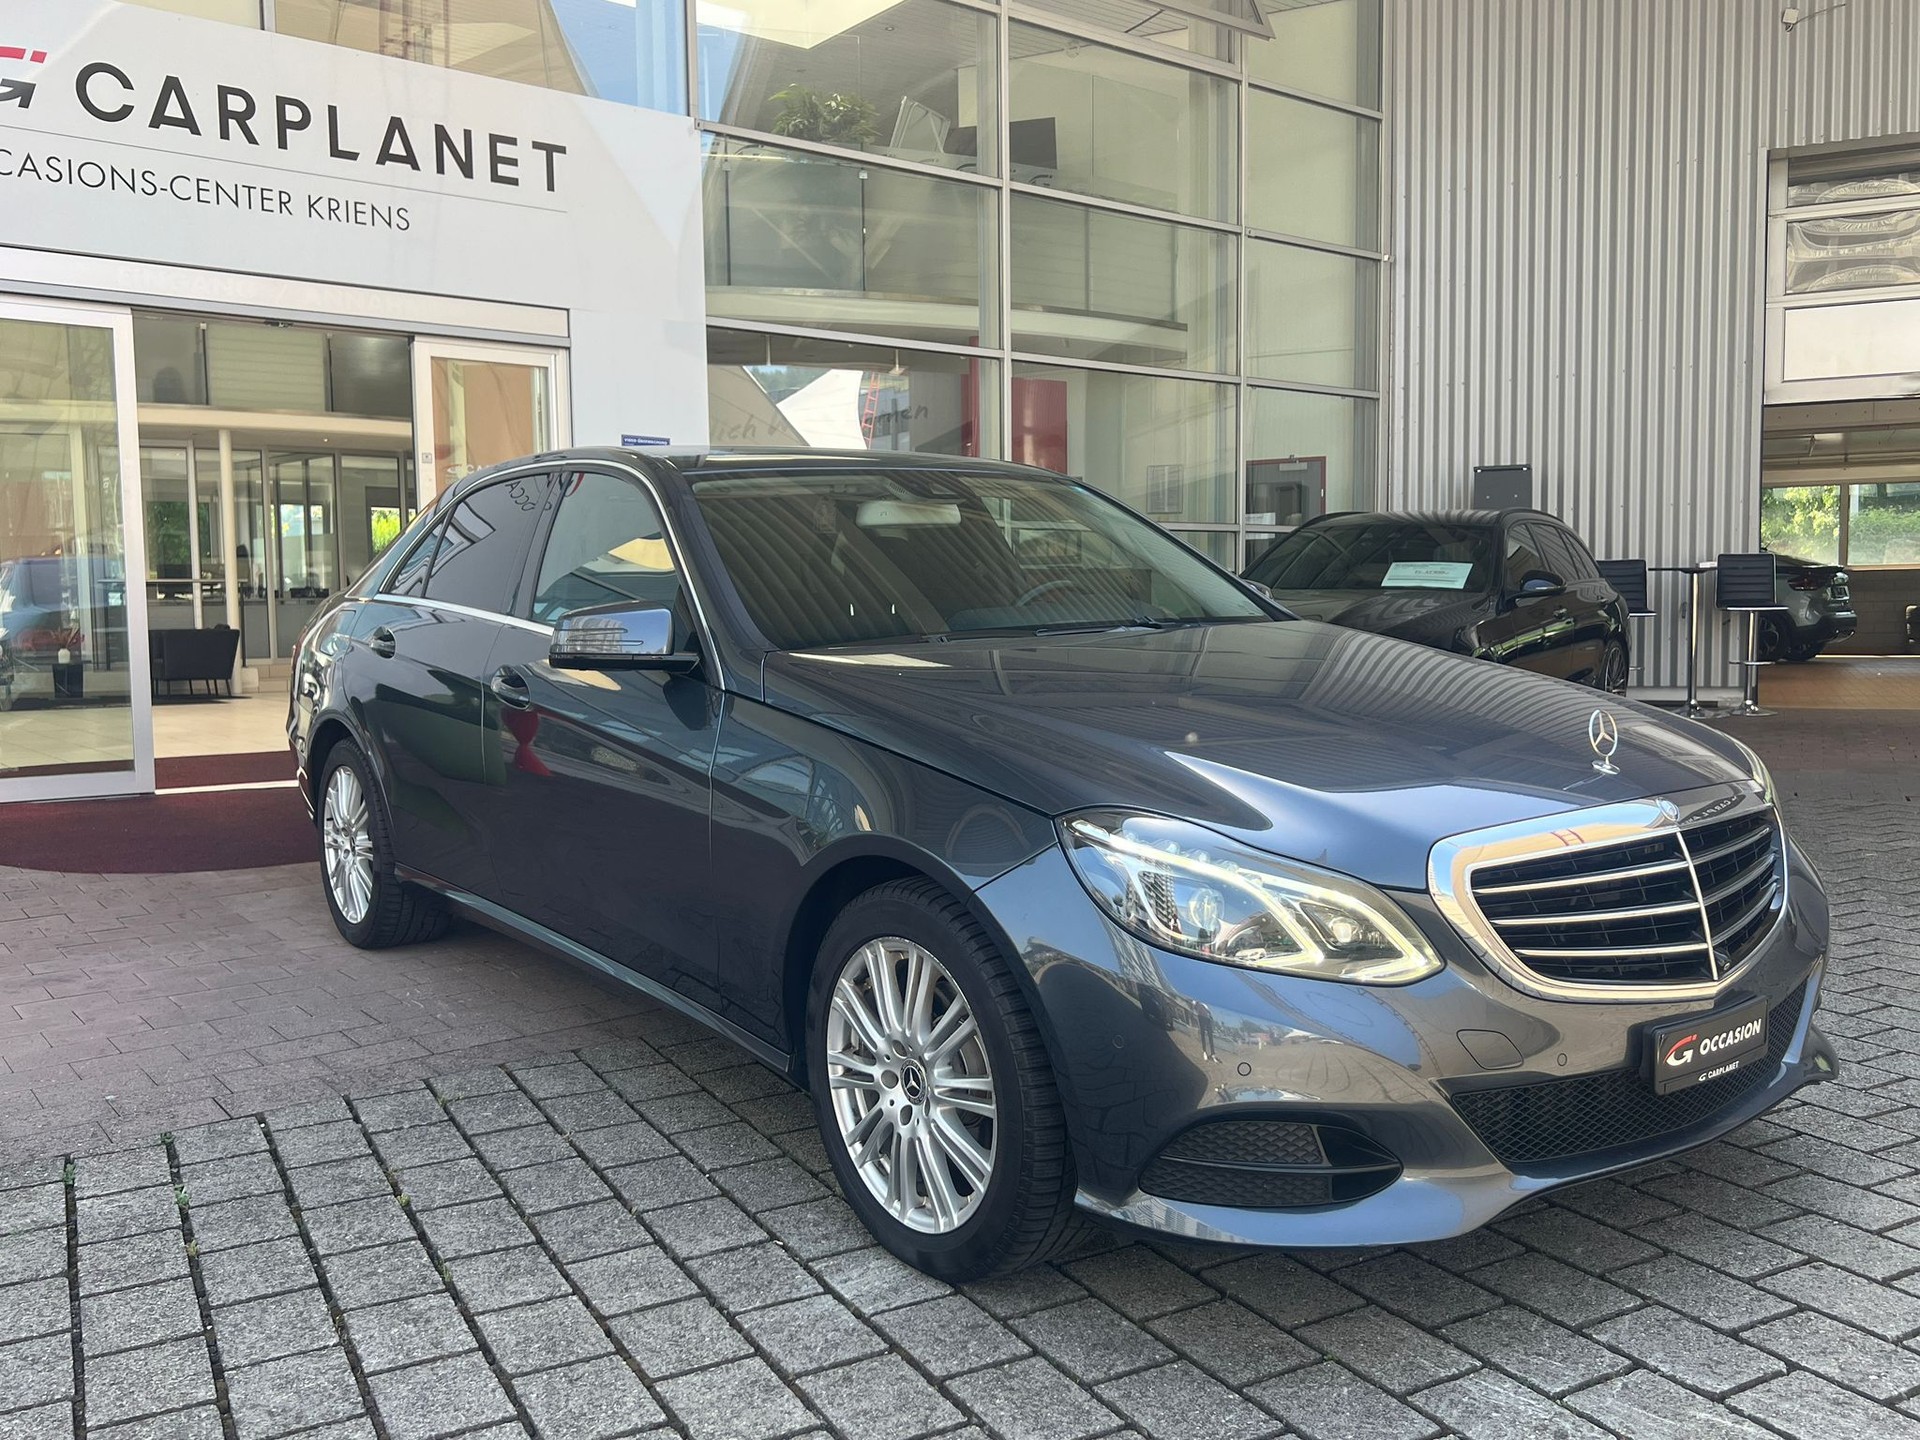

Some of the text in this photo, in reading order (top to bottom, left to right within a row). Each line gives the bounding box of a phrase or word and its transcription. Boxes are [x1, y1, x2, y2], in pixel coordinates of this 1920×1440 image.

[75, 62, 567, 193] CARPLANET
[308, 194, 410, 231] KRIENS
[1700, 1019, 1761, 1055] OCCASION
[1708, 1061, 1739, 1079] CARPLANET
